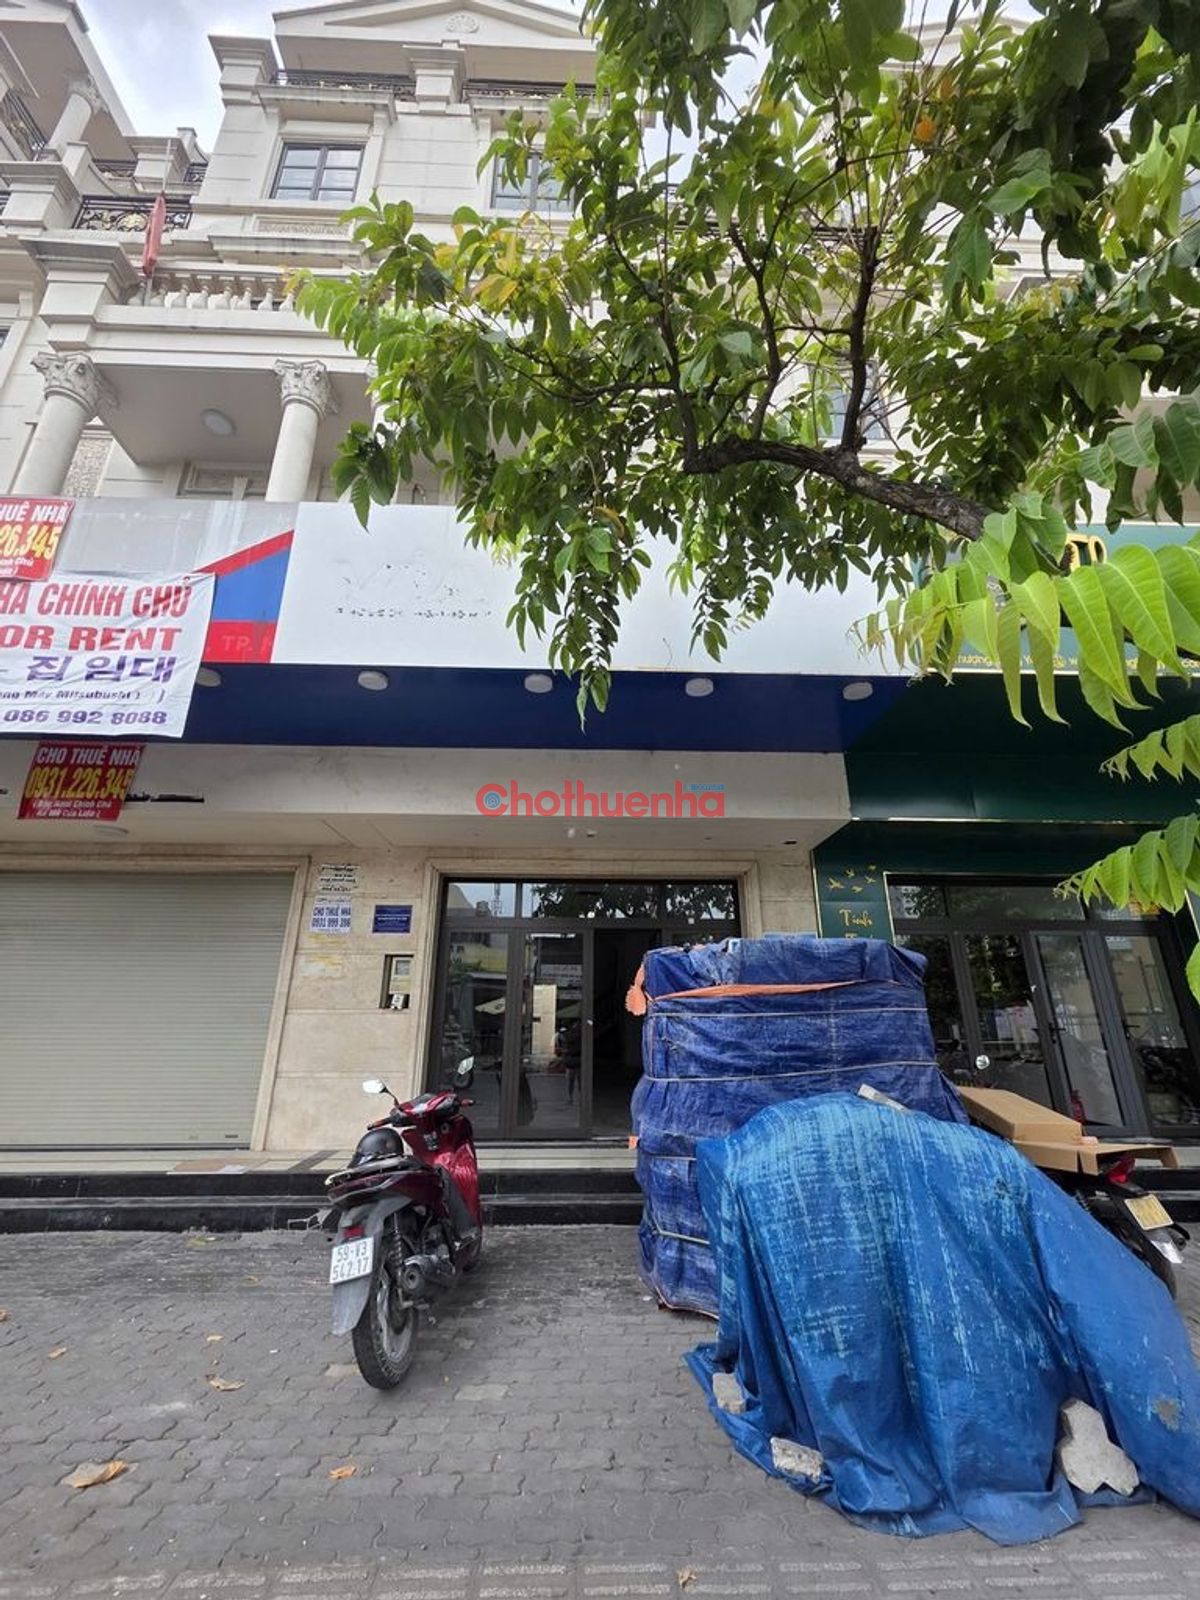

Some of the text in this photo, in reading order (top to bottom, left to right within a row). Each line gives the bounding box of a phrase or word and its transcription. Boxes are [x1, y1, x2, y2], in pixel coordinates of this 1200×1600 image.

[31, 502, 70, 523] NHÀ
[37, 579, 127, 616] CHÍNH
[132, 576, 193, 618] CHỦ
[68, 627, 182, 651] RENT
[26, 655, 176, 683] 집 임대
[3, 709, 167, 725] 086 992 8088
[36, 744, 140, 766] CHO THUÊ NHÀ
